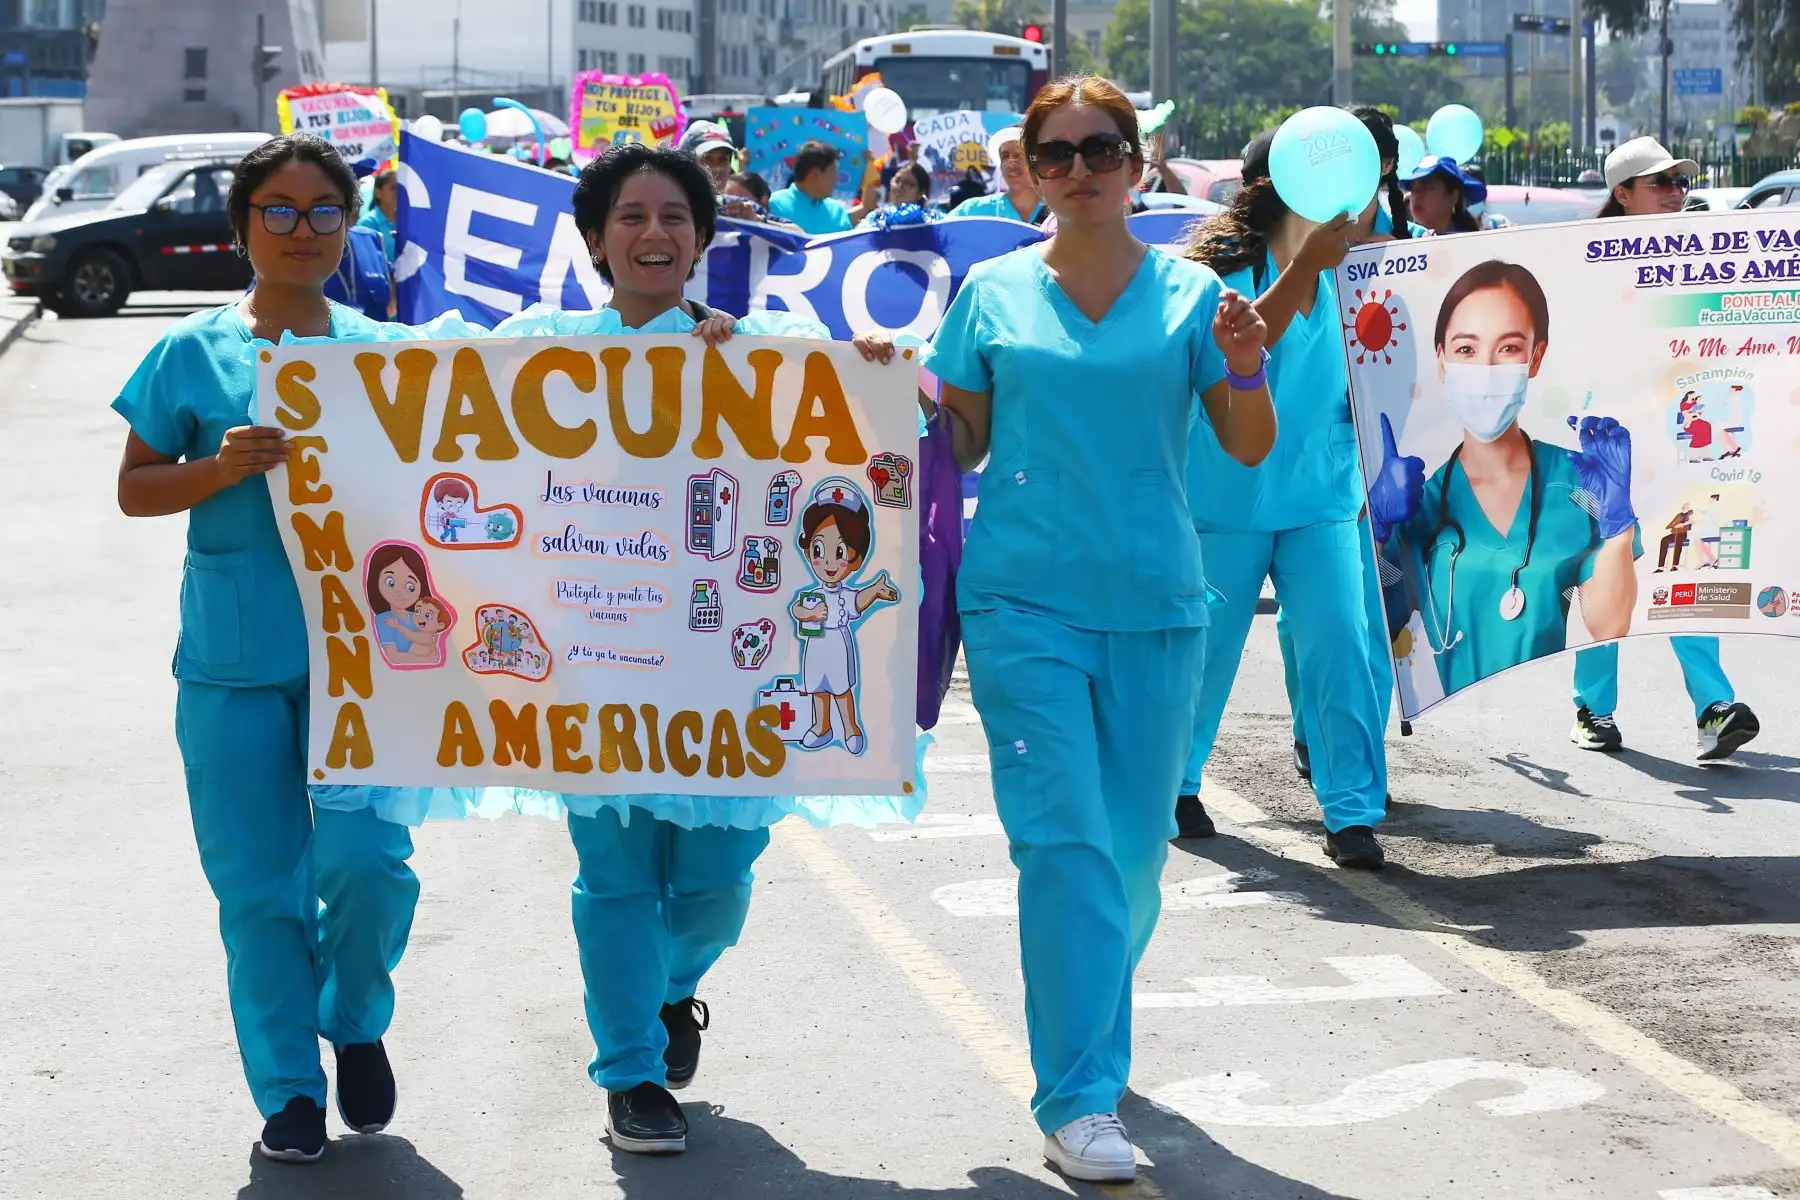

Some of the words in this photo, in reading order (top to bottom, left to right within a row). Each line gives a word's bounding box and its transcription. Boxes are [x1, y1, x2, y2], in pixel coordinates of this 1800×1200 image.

[295, 117, 303, 129] A
[308, 113, 331, 127] TUS
[618, 116, 640, 127] DEL
[916, 113, 970, 136] CADA
[1303, 130, 1349, 159] 2023
[1586, 233, 1704, 260] SEMANA
[1711, 230, 1749, 251] DE
[1347, 261, 1380, 282] SVA
[1384, 254, 1428, 276] 2023
[1637, 264, 1675, 285] EN
[1682, 261, 1736, 282] LAS
[1723, 295, 1771, 309] PONTE
[1775, 294, 1793, 307] AL
[1669, 339, 1691, 358] Yo
[1698, 337, 1728, 357] Me
[1736, 336, 1780, 356] Amo,
[1676, 366, 1755, 389] Sarampión
[354, 346, 868, 465] VACUNA
[1711, 466, 1744, 482] Covid
[1747, 469, 1762, 484] 19
[540, 470, 575, 504] Las
[583, 483, 664, 509] vacunas
[542, 524, 609, 555] salvan
[616, 531, 670, 561] vidas
[274, 360, 375, 769] SEMANA
[606, 589, 614, 606] y
[617, 586, 645, 606] ponte
[646, 588, 663, 604] tus
[1675, 590, 1693, 598] PERÚ
[589, 608, 628, 623] vacunas
[567, 644, 579, 661] ¿Y
[583, 647, 593, 657] tú
[595, 651, 606, 662] ya
[609, 649, 617, 661] te
[619, 655, 665, 667] vacunaste?
[436, 699, 786, 778] AMERICAS
